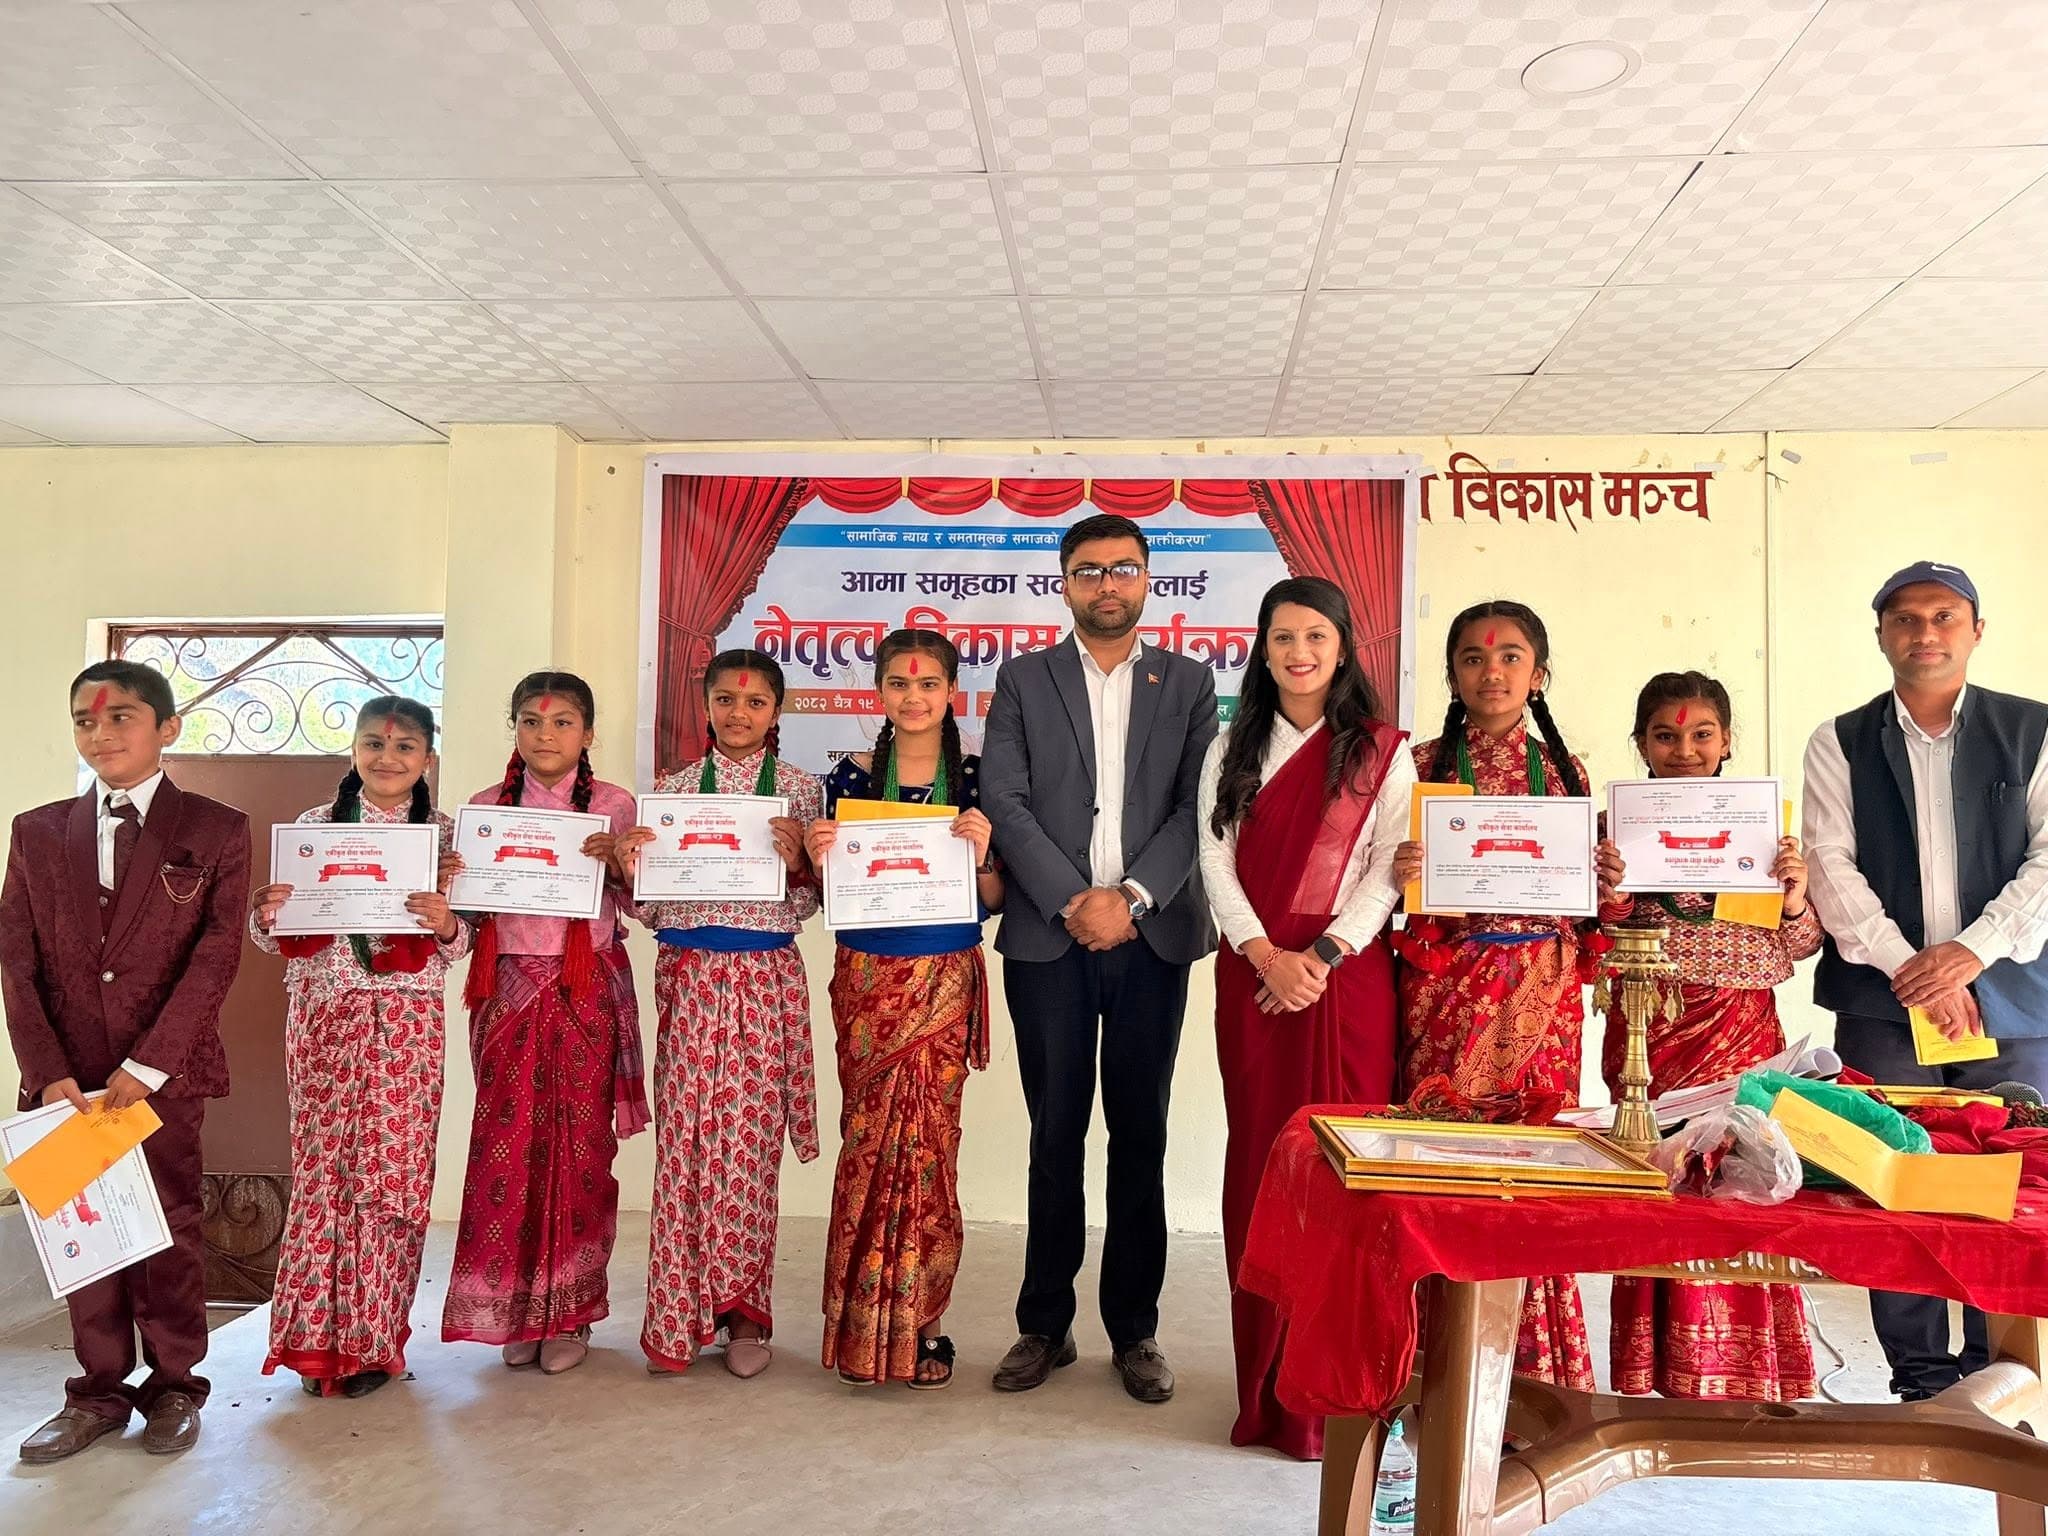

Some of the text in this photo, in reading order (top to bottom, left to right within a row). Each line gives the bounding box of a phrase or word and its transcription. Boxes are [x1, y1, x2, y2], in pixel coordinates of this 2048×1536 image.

[1444, 452, 1595, 533] विकास
[1599, 471, 1716, 523] मञ्च
[902, 531, 928, 543] न्याय
[933, 532, 942, 545] र
[948, 532, 1006, 547] समतामूलक
[1012, 531, 1059, 545] समाजको
[841, 571, 907, 593] आमा
[916, 573, 1018, 600] समूहका
[754, 604, 888, 678] नेतृत्व
[795, 697, 827, 711] २०८२
[833, 693, 853, 709] चैत्र
[858, 698, 874, 711] १९
